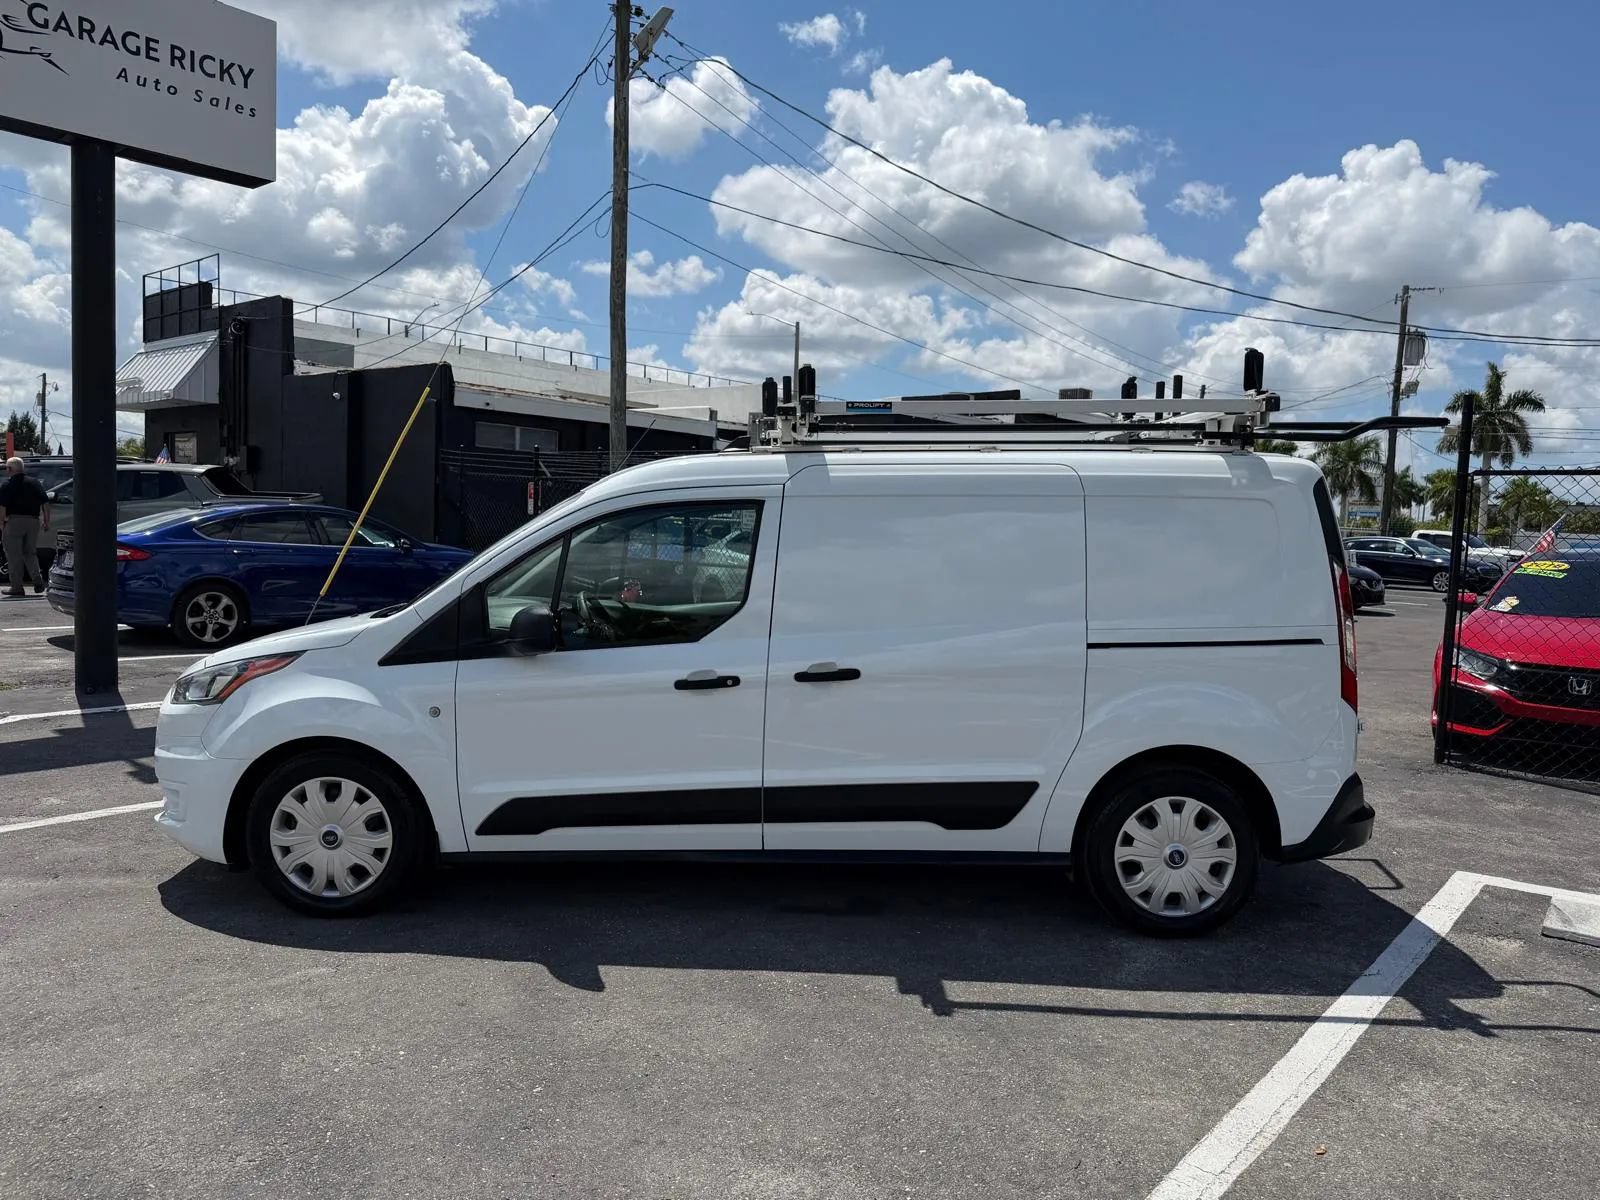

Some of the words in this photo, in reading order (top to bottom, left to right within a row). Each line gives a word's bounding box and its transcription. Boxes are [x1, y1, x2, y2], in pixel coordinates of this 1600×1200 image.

[27, 3, 160, 62] GARAGE
[170, 43, 254, 89] RICKY
[116, 67, 178, 95] Auto
[193, 89, 257, 118] Sales
